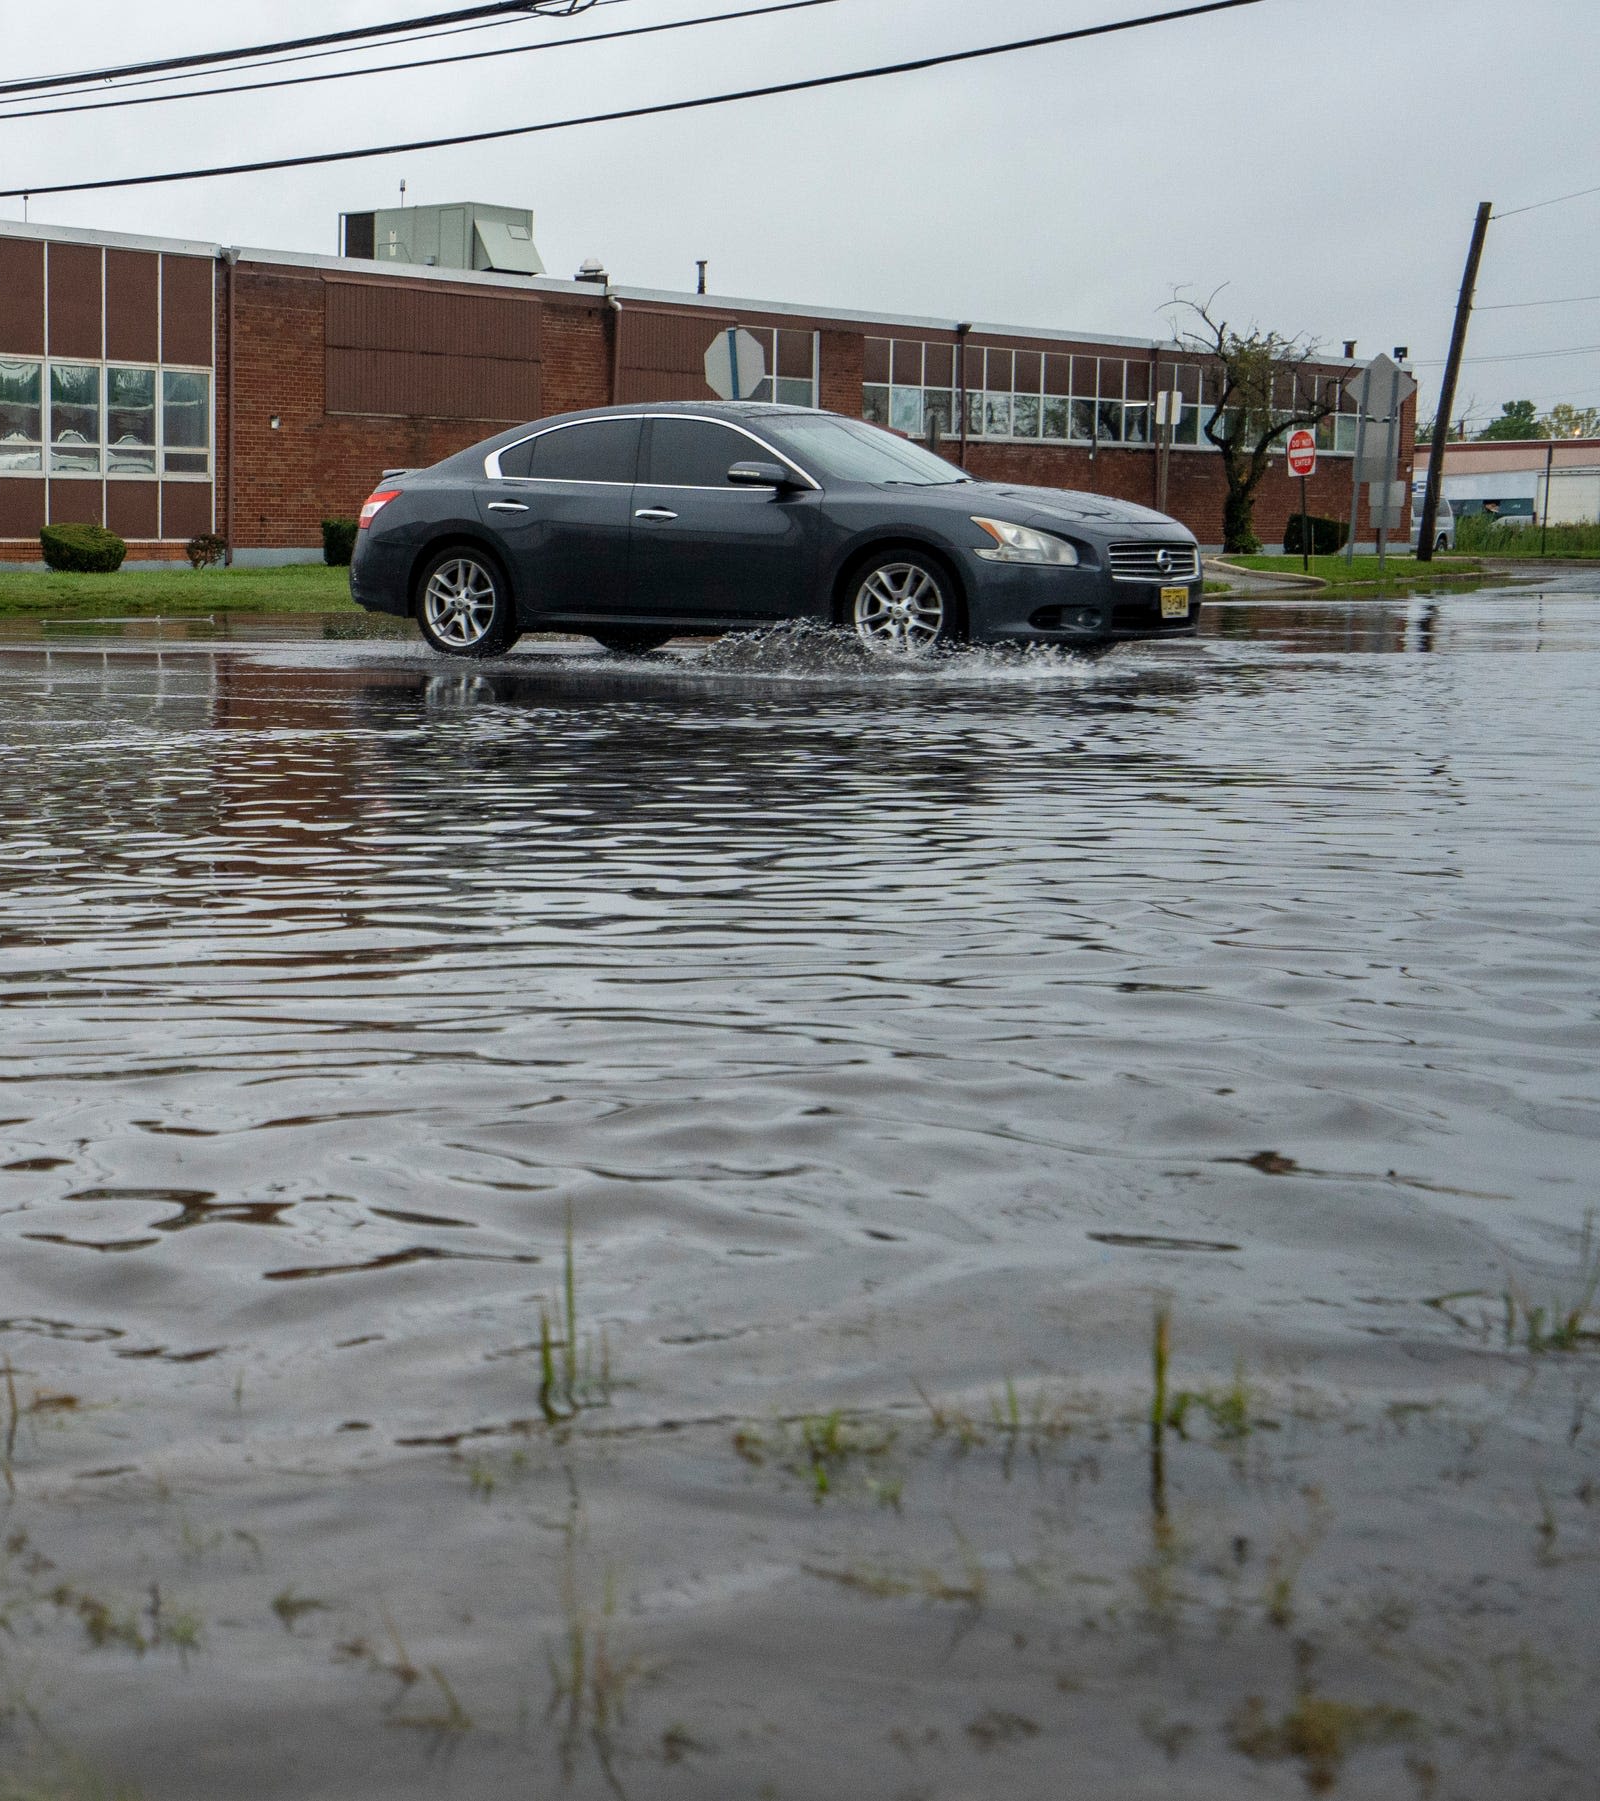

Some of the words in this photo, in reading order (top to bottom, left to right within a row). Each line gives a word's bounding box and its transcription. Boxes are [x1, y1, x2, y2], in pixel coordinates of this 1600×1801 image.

[1291, 439, 1300, 448] DO
[1301, 438, 1312, 447] NOT
[1295, 458, 1311, 468] ENTER
